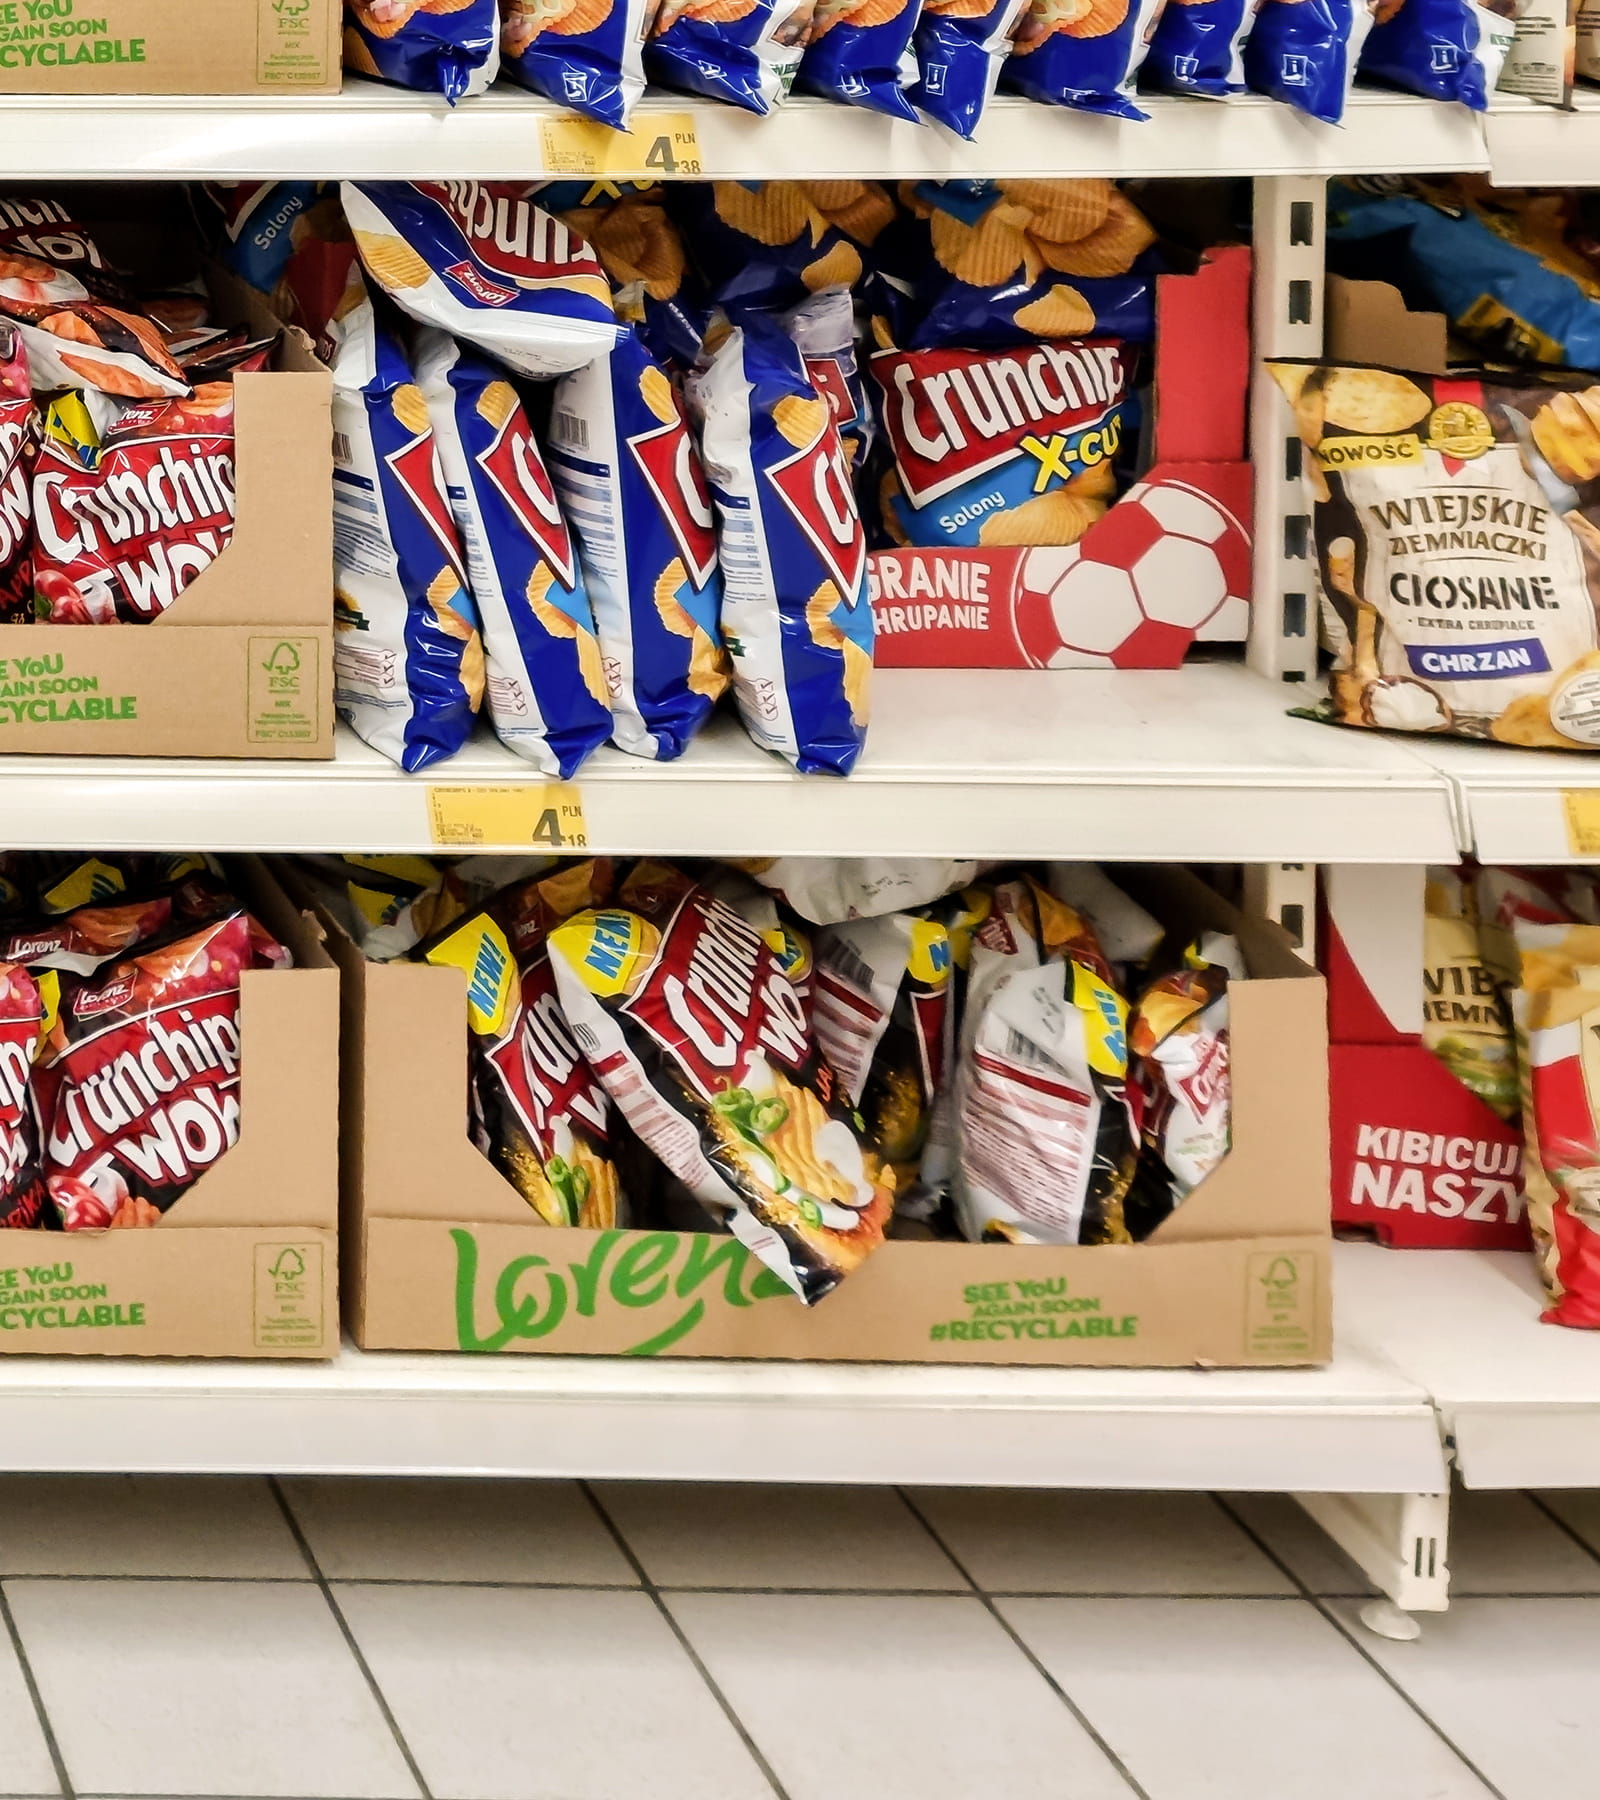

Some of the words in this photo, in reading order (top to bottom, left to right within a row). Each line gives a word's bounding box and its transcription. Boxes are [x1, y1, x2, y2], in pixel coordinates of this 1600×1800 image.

[49, 16, 108, 38] SOON
[276, 17, 311, 31] FSC
[646, 134, 679, 175] 4
[675, 132, 695, 144] PLN
[680, 159, 701, 175] 38
[254, 196, 301, 250] Solony
[939, 489, 1006, 536] Solony
[1369, 495, 1548, 534] WIEJSKIE
[1390, 531, 1546, 561] ZIEMNIACZKI
[1390, 572, 1560, 610] CIOSANE
[1421, 647, 1531, 673] CHRZAN
[40, 675, 98, 694] SOON
[268, 674, 300, 689] FSC
[532, 808, 565, 847] 4
[562, 805, 582, 818] PLN
[584, 911, 631, 980] NEW!
[467, 931, 508, 1019] NEW!
[80, 983, 130, 1006] Lorenz
[1355, 1123, 1522, 1176] KIBICUJ
[49, 1283, 107, 1300] SOON
[964, 1281, 1014, 1305] SEE
[972, 1299, 1034, 1318] AGAIN
[1040, 1296, 1100, 1313] SOON
[930, 1317, 1138, 1343] #RECYCLABLE
